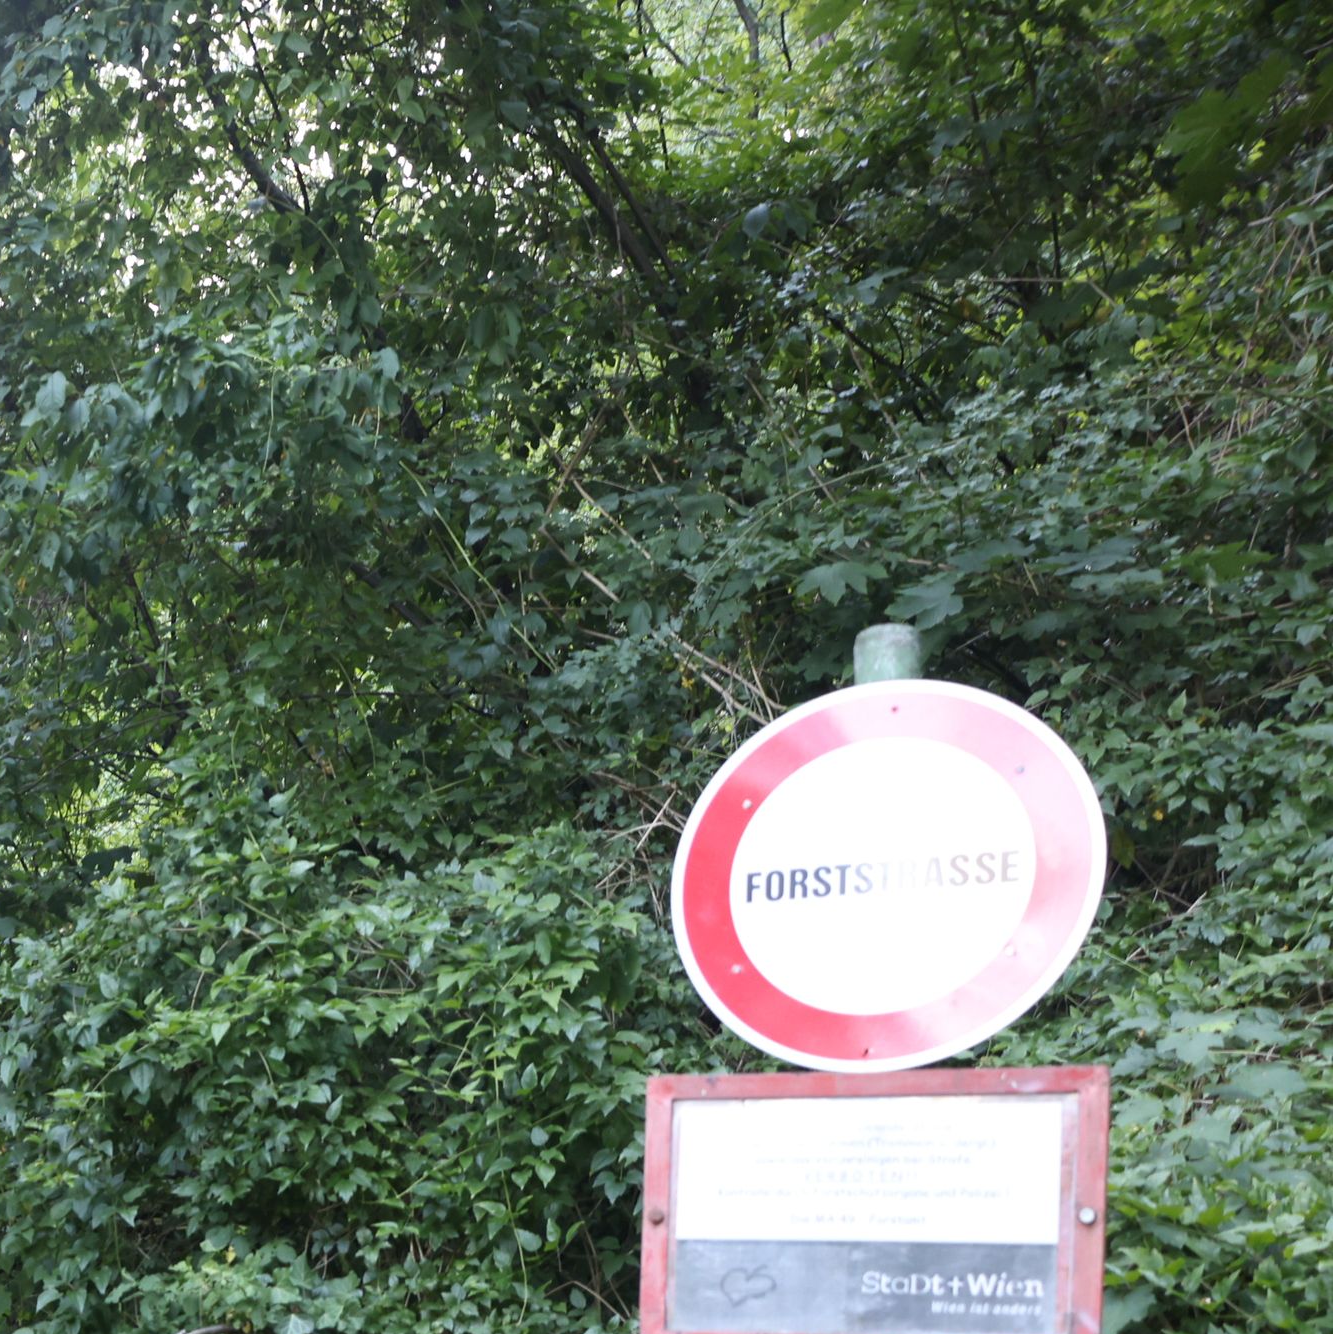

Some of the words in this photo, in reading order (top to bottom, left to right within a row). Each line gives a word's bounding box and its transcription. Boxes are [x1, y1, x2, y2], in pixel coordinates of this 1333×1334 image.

[745, 849, 1021, 903] FORSTSTRASSE
[931, 1301, 966, 1314] Wien
[969, 1302, 989, 1315] ist
